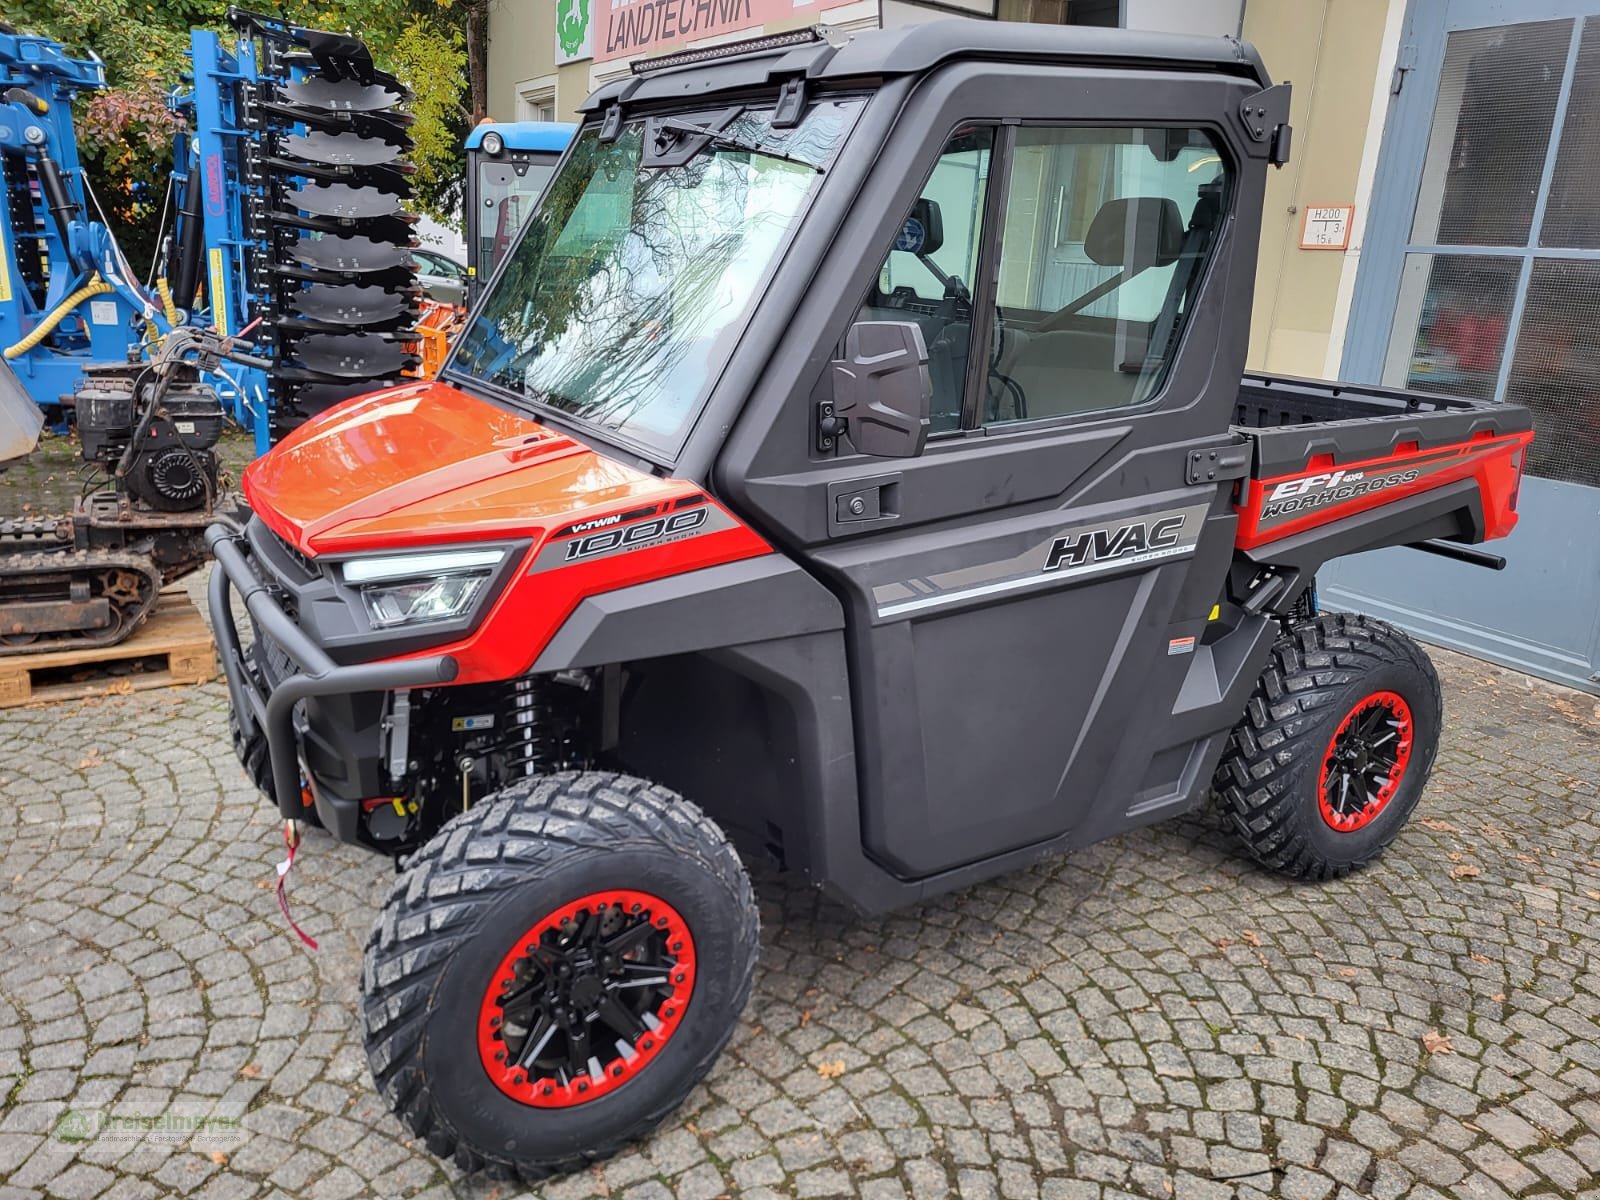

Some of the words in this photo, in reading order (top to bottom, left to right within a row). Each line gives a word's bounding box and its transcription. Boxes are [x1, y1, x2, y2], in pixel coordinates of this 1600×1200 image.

[1260, 469, 1419, 521] WORKCROSS
[1269, 470, 1346, 501] EFI
[565, 506, 709, 561] 1000
[571, 514, 622, 534] V-TWIN
[1042, 514, 1186, 572] HVAC
